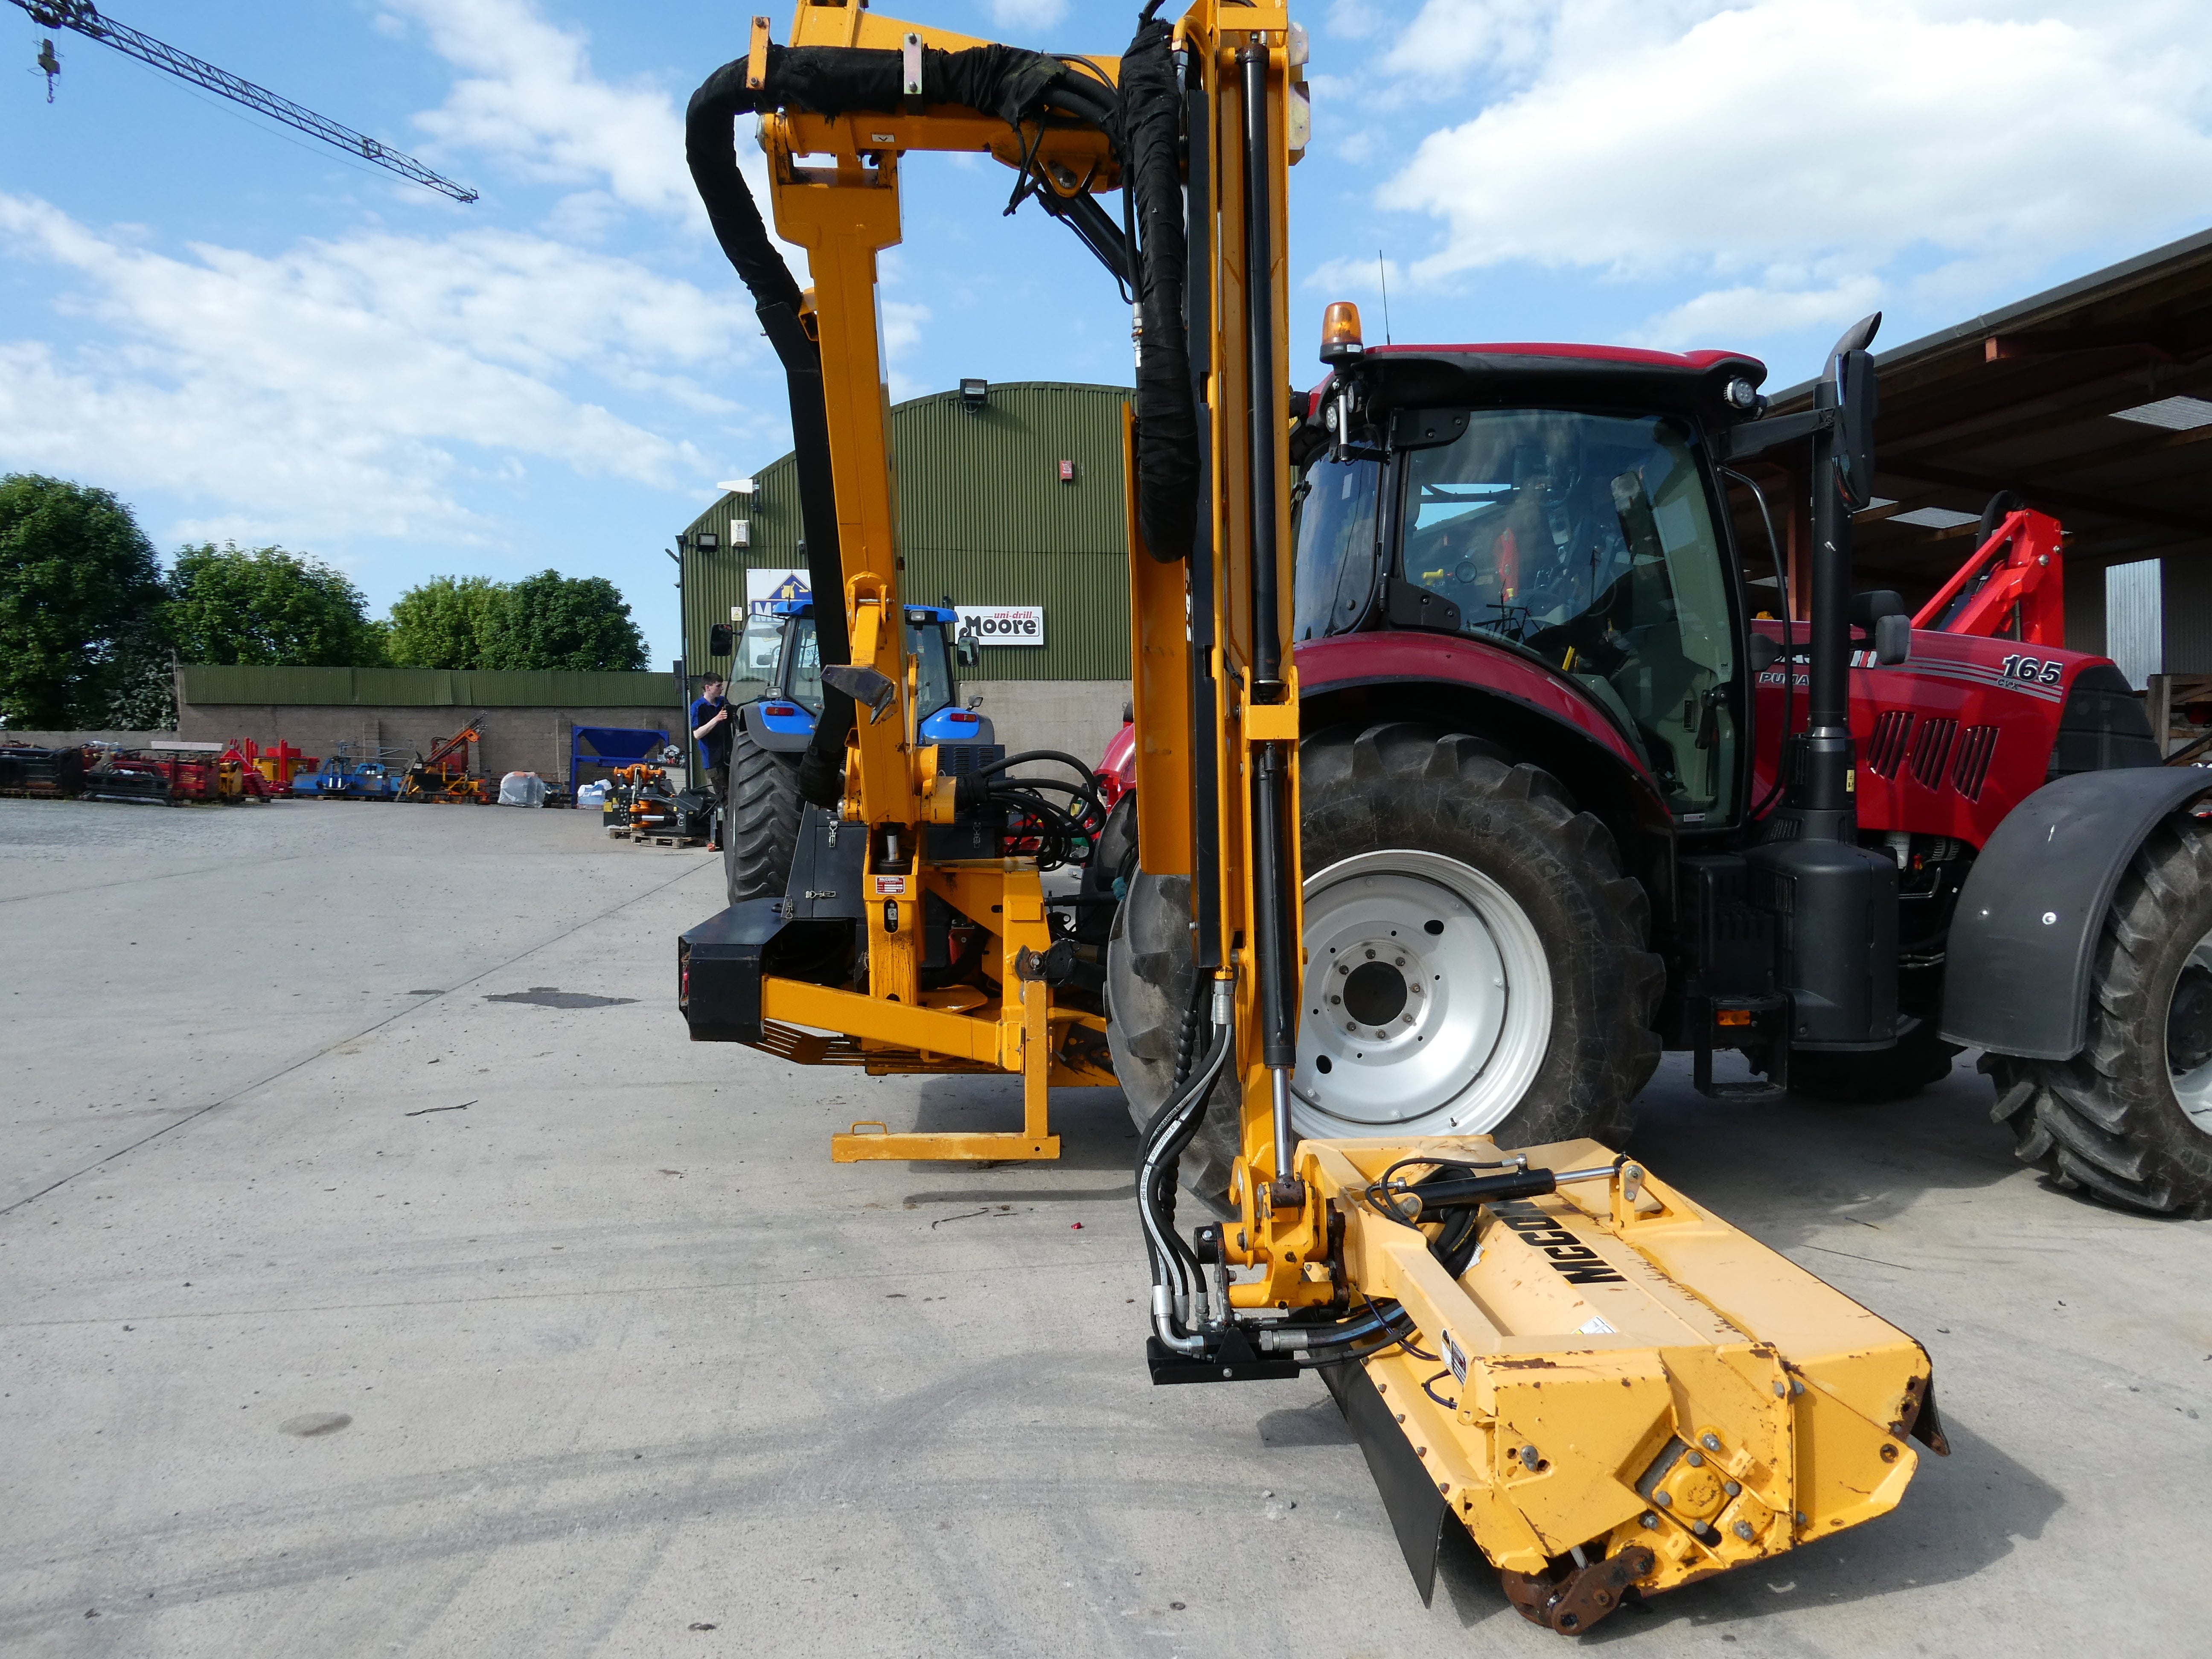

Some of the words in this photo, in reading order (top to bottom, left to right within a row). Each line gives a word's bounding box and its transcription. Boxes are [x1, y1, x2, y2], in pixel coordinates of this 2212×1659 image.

[959, 615, 1036, 636] Moore
[2002, 654, 2063, 685] 165
[1997, 678, 2020, 690] CVX
